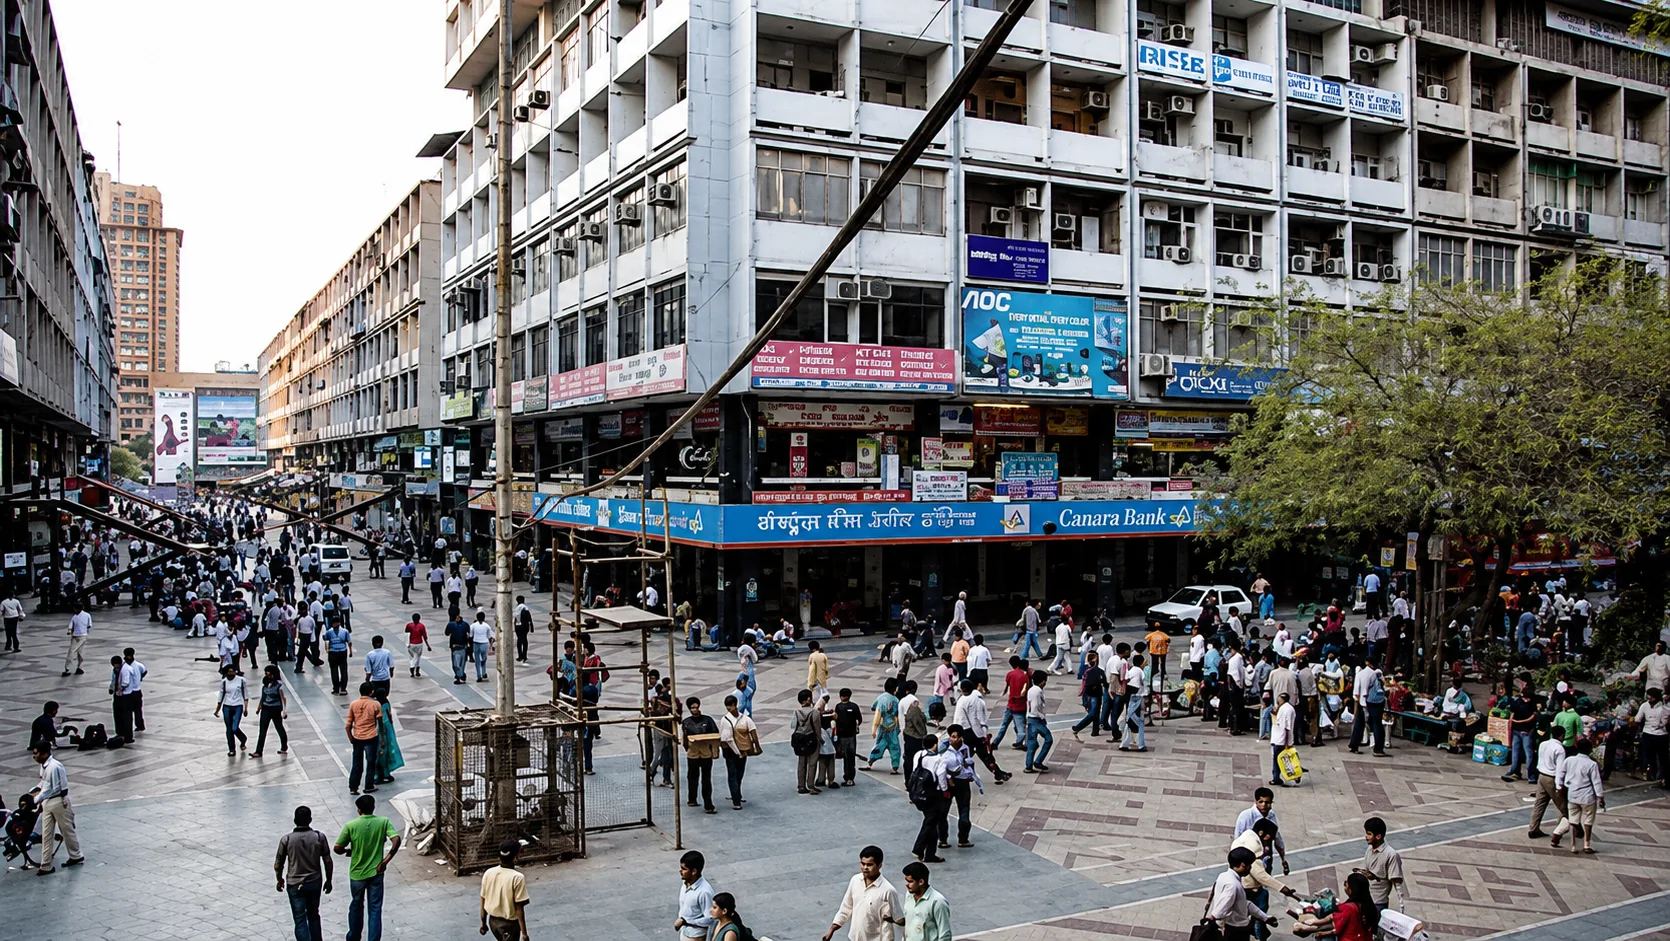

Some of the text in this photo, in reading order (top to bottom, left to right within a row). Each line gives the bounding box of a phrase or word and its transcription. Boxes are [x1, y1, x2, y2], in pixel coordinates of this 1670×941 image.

[962, 290, 1011, 312] AOC
[1059, 507, 1166, 528] Canara Bank
